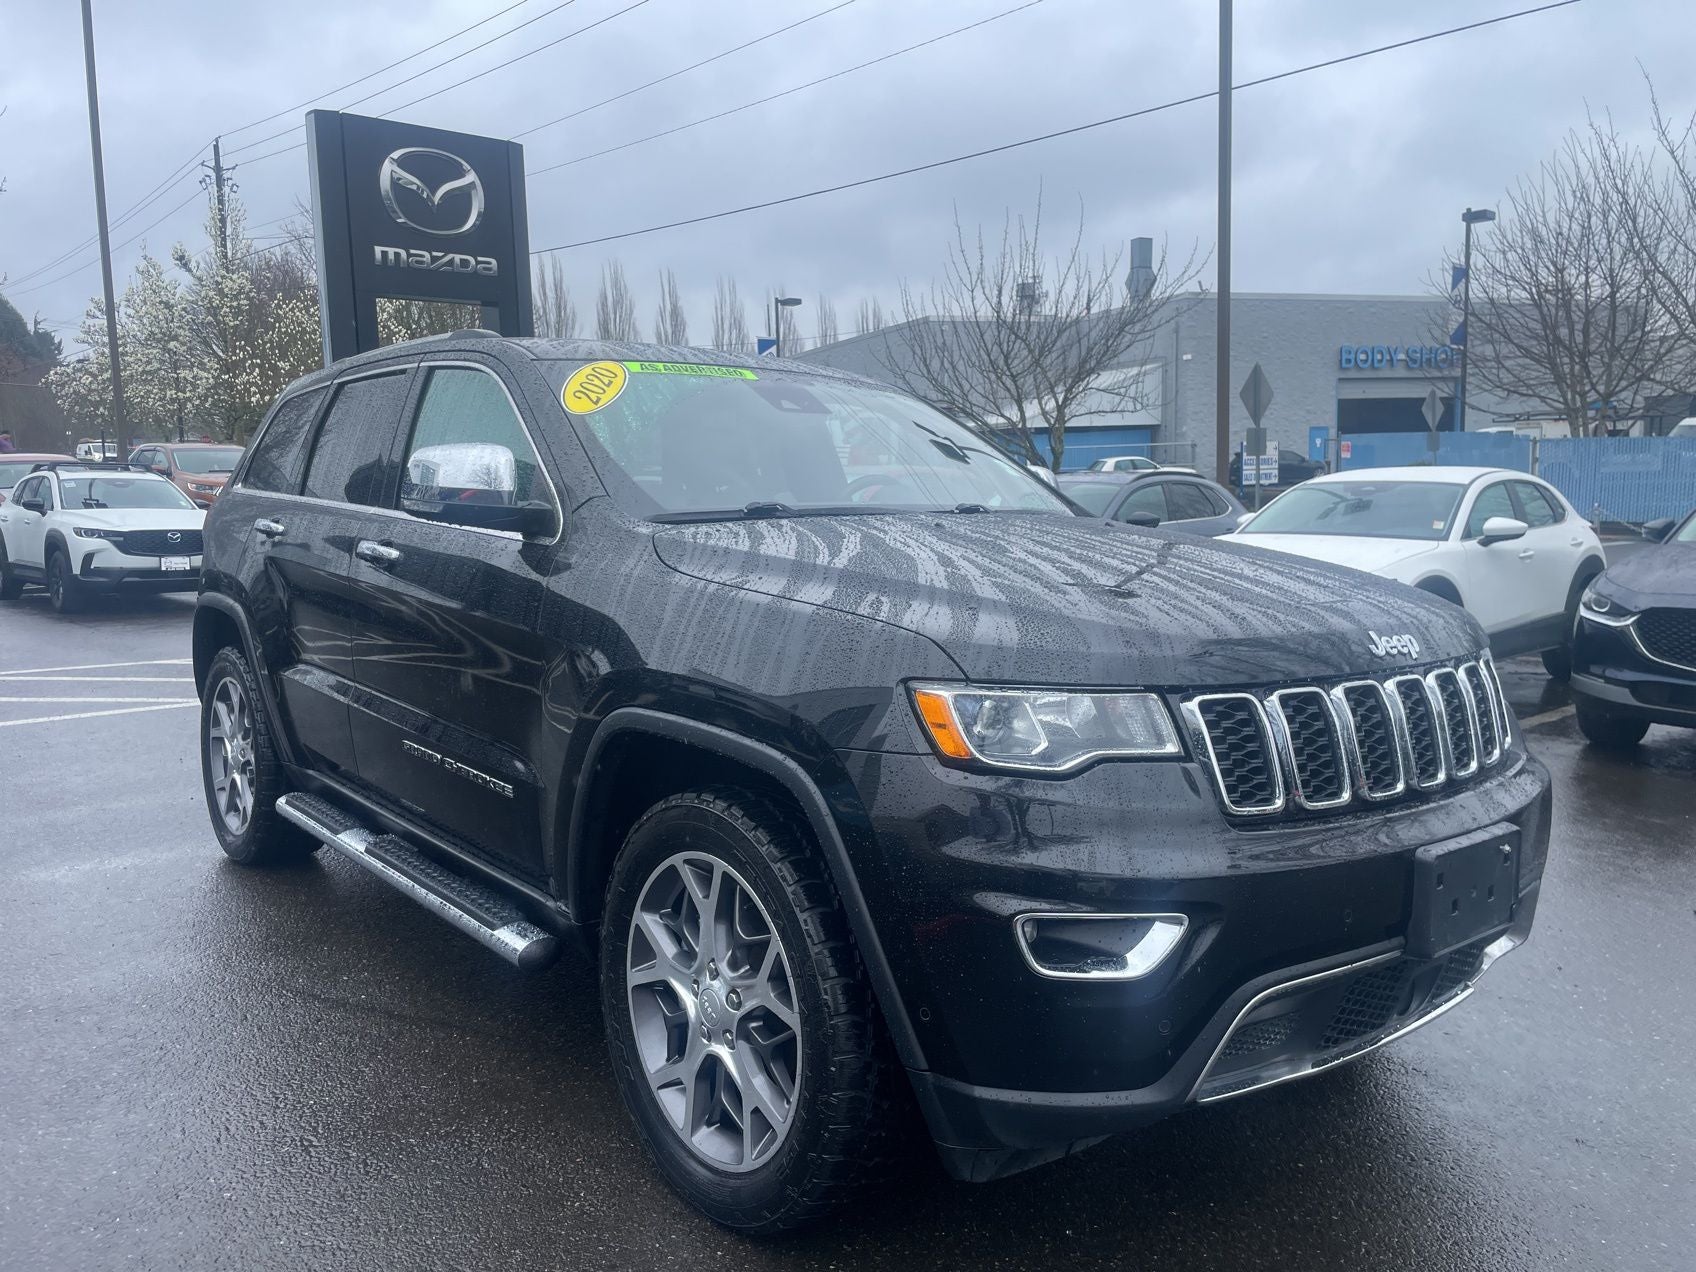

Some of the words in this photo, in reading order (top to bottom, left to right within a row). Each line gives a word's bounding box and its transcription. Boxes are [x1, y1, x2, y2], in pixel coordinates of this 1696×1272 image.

[640, 362, 659, 372] AS
[662, 363, 745, 377] ADVERTISED
[1340, 344, 1399, 369] BODY
[572, 366, 618, 406] 2020
[1368, 630, 1420, 660] Jeep
